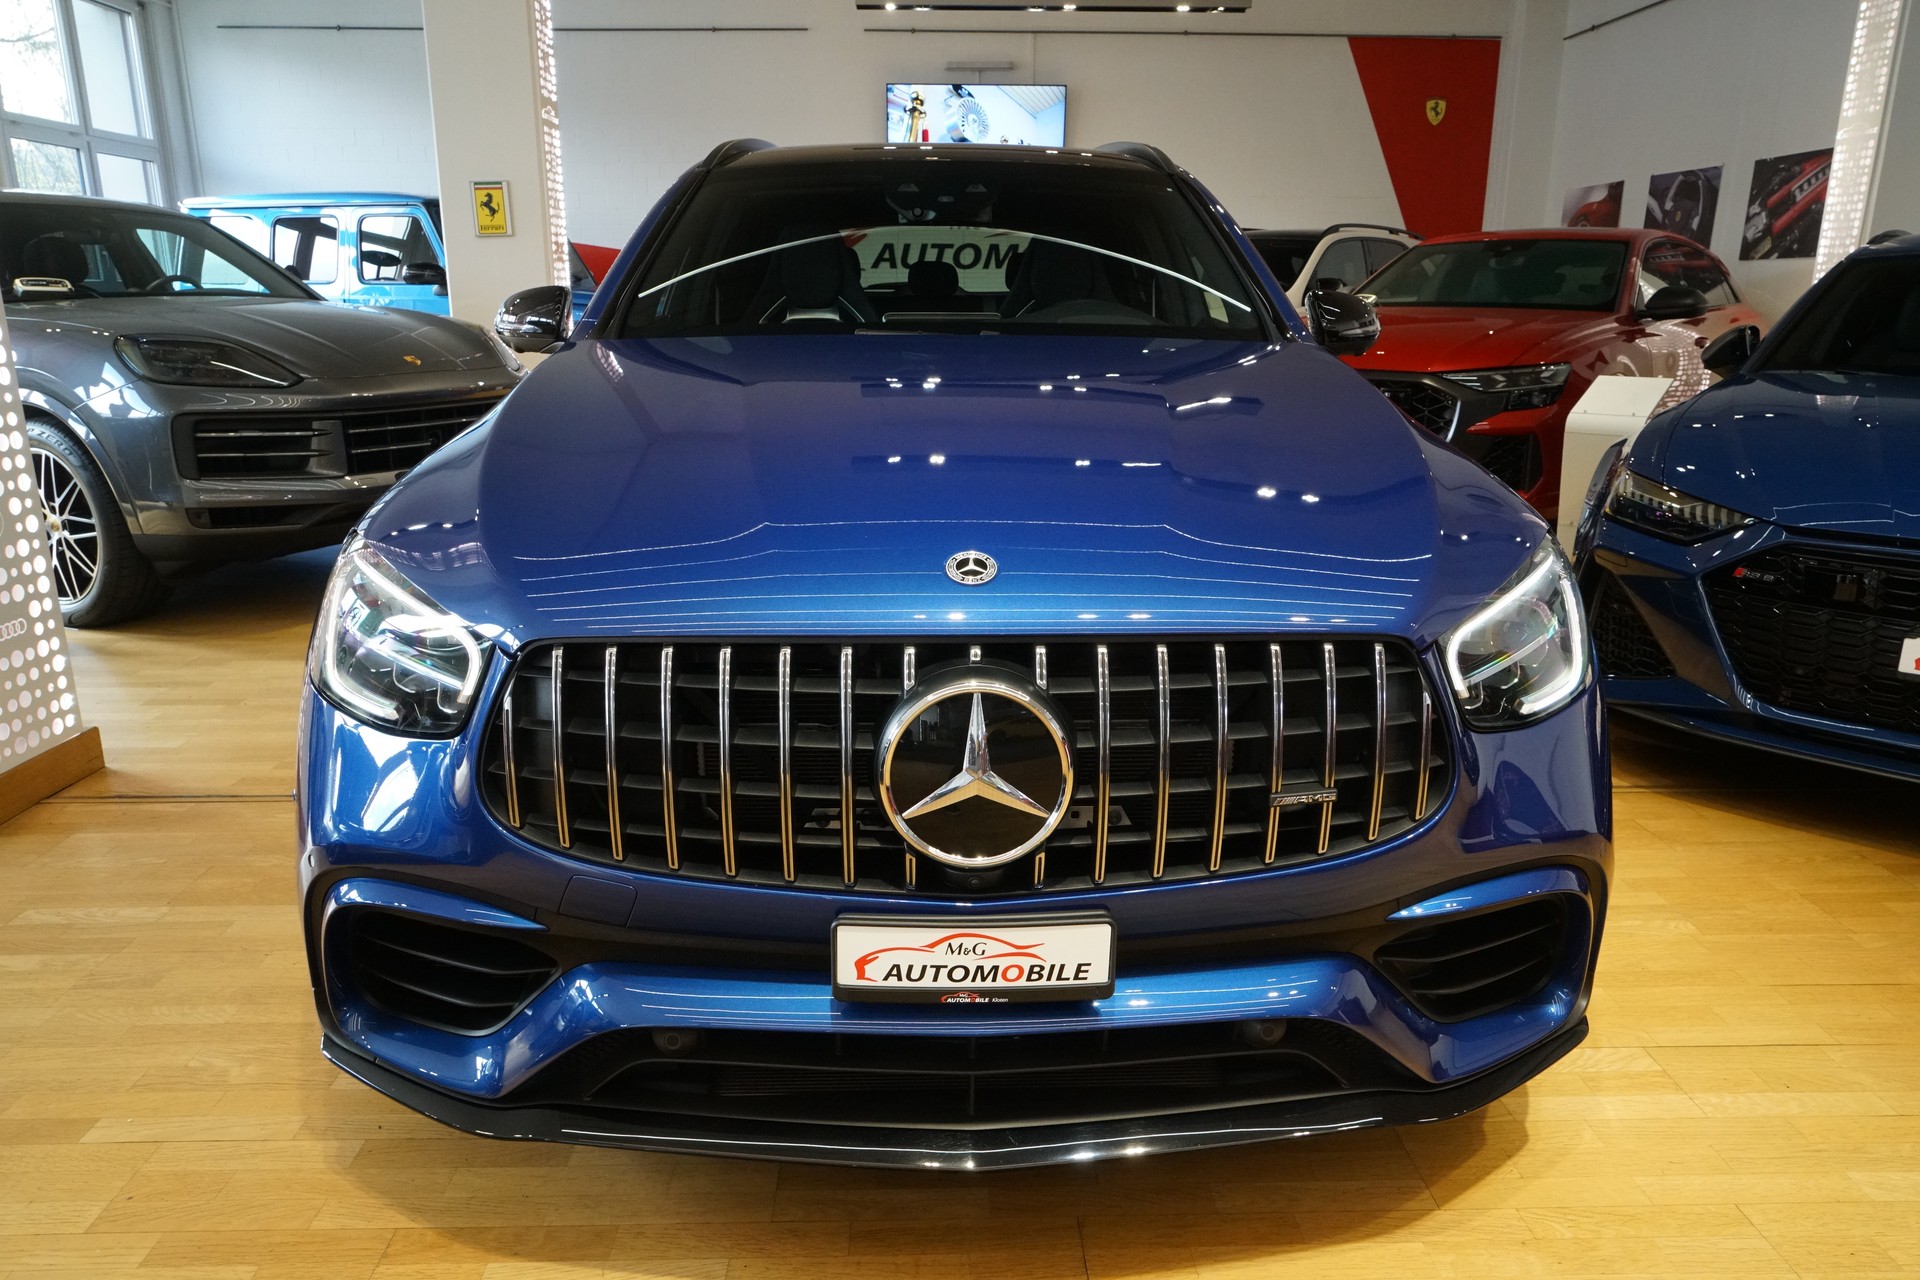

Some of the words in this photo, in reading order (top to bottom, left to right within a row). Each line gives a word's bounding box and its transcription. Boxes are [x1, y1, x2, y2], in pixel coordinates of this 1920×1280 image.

[36, 431, 74, 456] ZERO
[945, 941, 988, 956] M&G
[882, 962, 1092, 983] AUTOMOBILE
